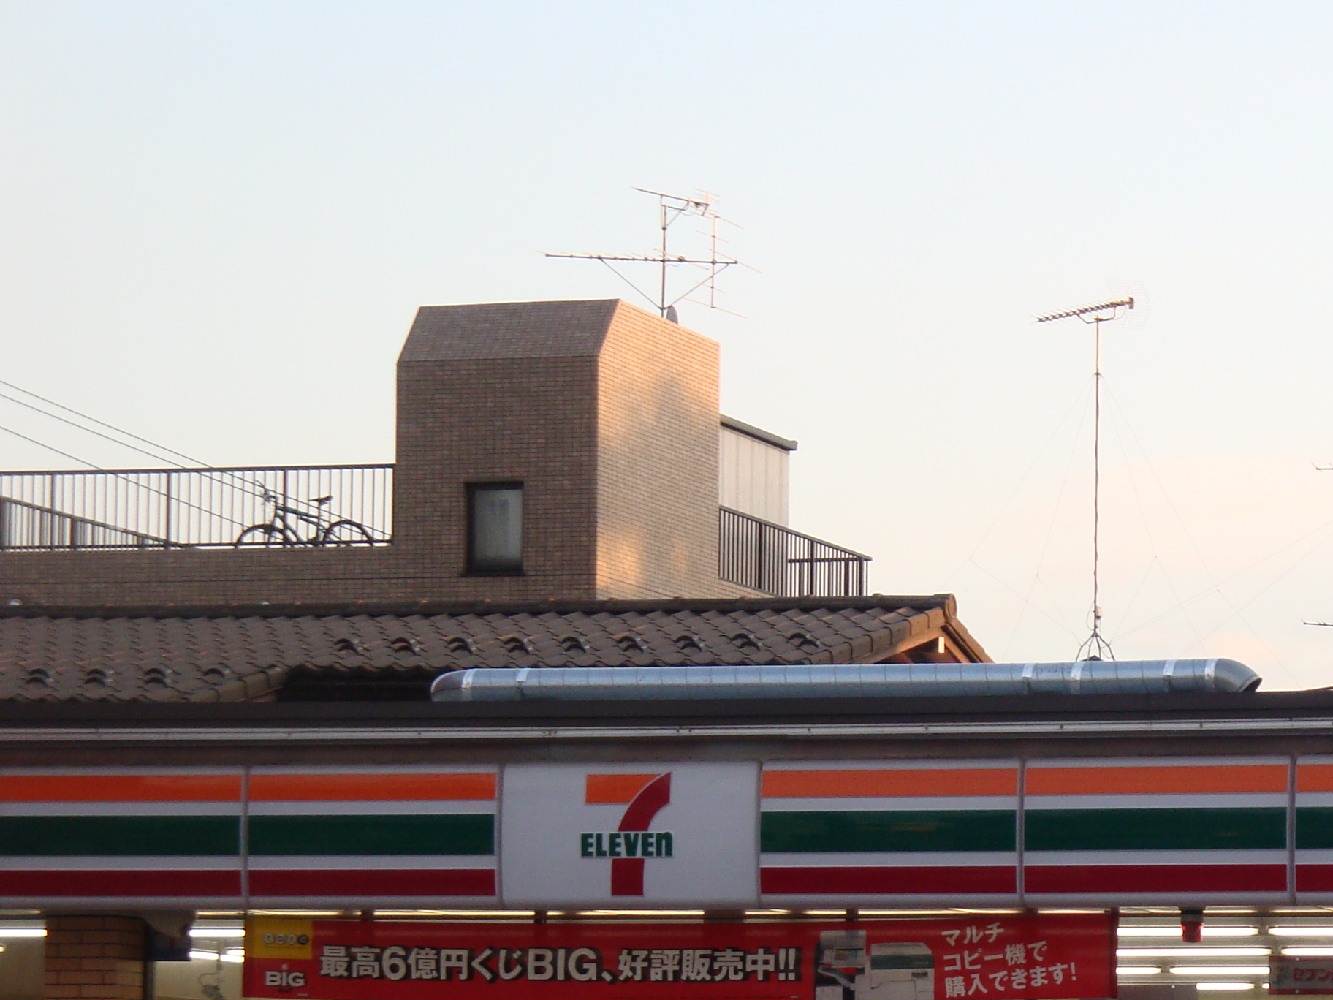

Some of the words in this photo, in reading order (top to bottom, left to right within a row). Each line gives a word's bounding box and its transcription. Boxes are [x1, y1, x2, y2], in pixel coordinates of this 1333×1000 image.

[585, 771, 672, 896] 7
[941, 922, 1004, 947] マルチ
[943, 940, 1048, 972] コピー機で
[264, 969, 306, 987] BIG
